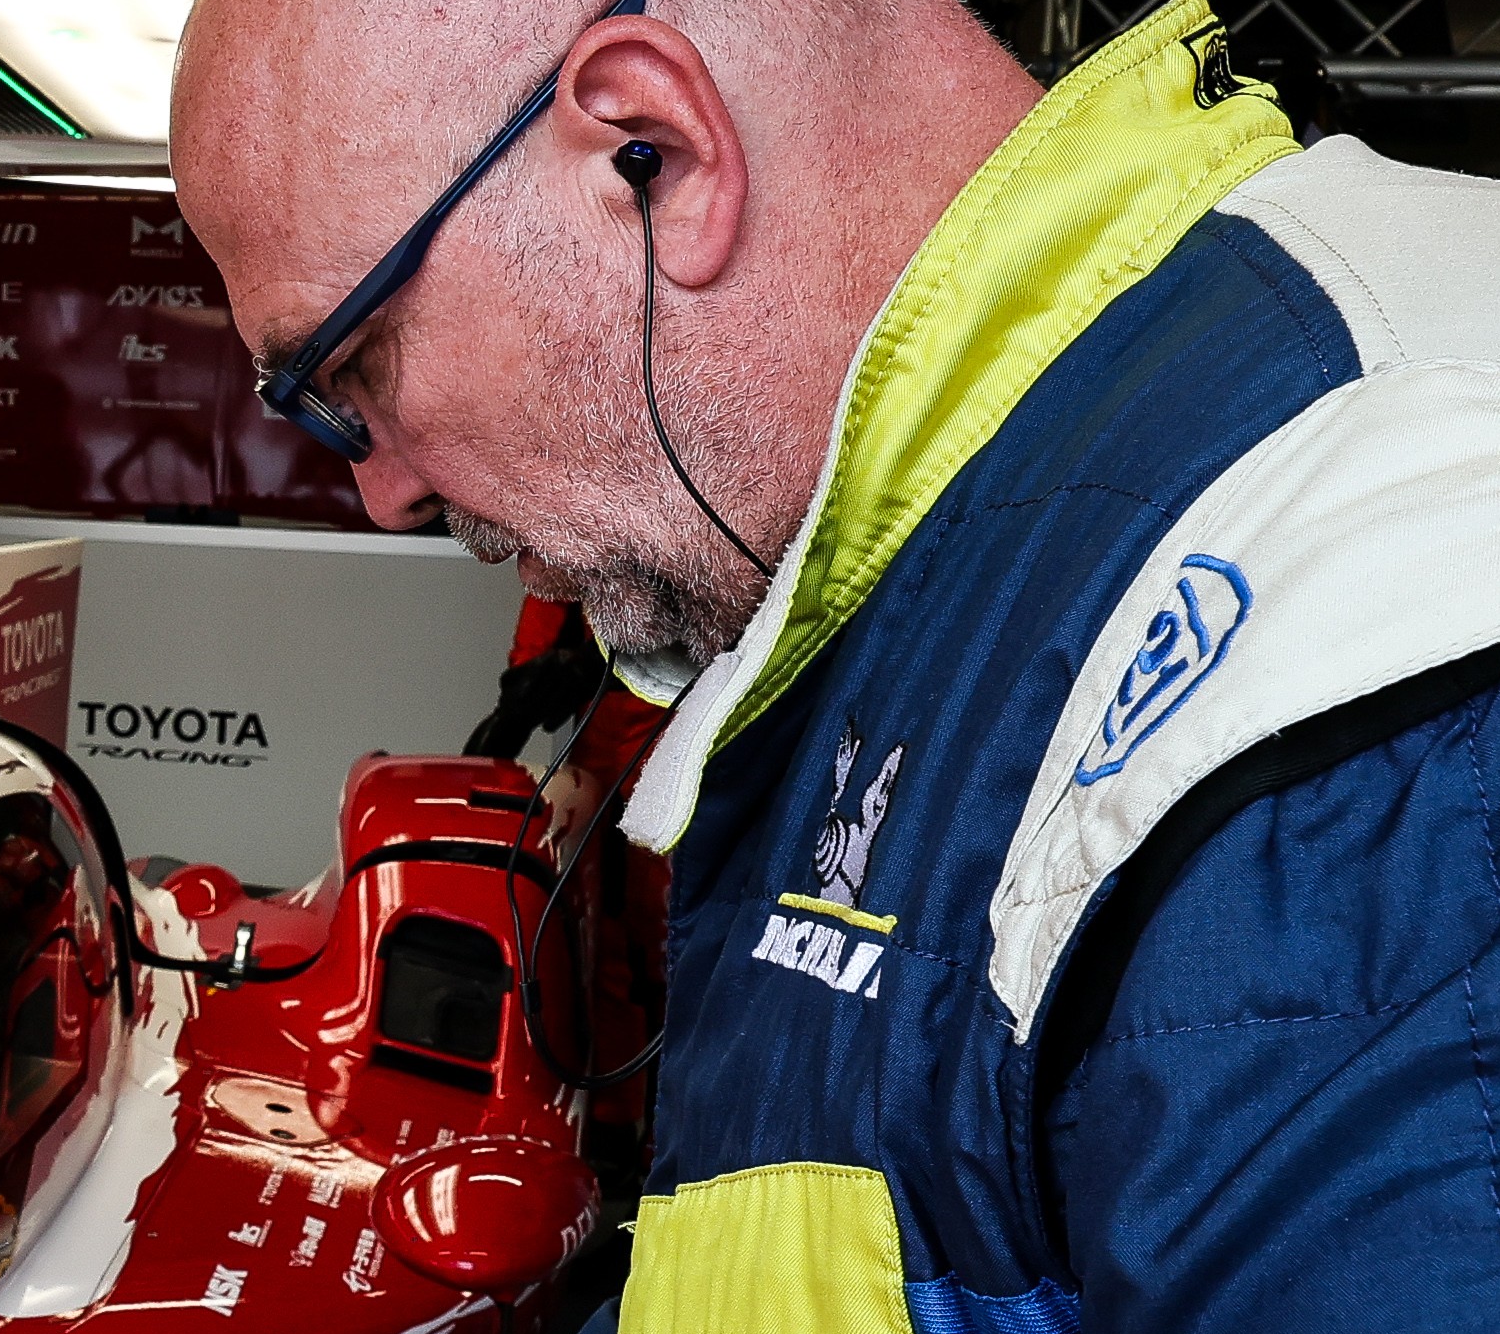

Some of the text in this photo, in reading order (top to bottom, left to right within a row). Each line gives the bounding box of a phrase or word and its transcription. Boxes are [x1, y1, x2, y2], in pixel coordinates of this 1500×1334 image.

[1, 610, 65, 675] TOYOTA
[77, 701, 270, 749] TOYOTA
[77, 742, 270, 769] RACING
[203, 1263, 249, 1318] NSK
